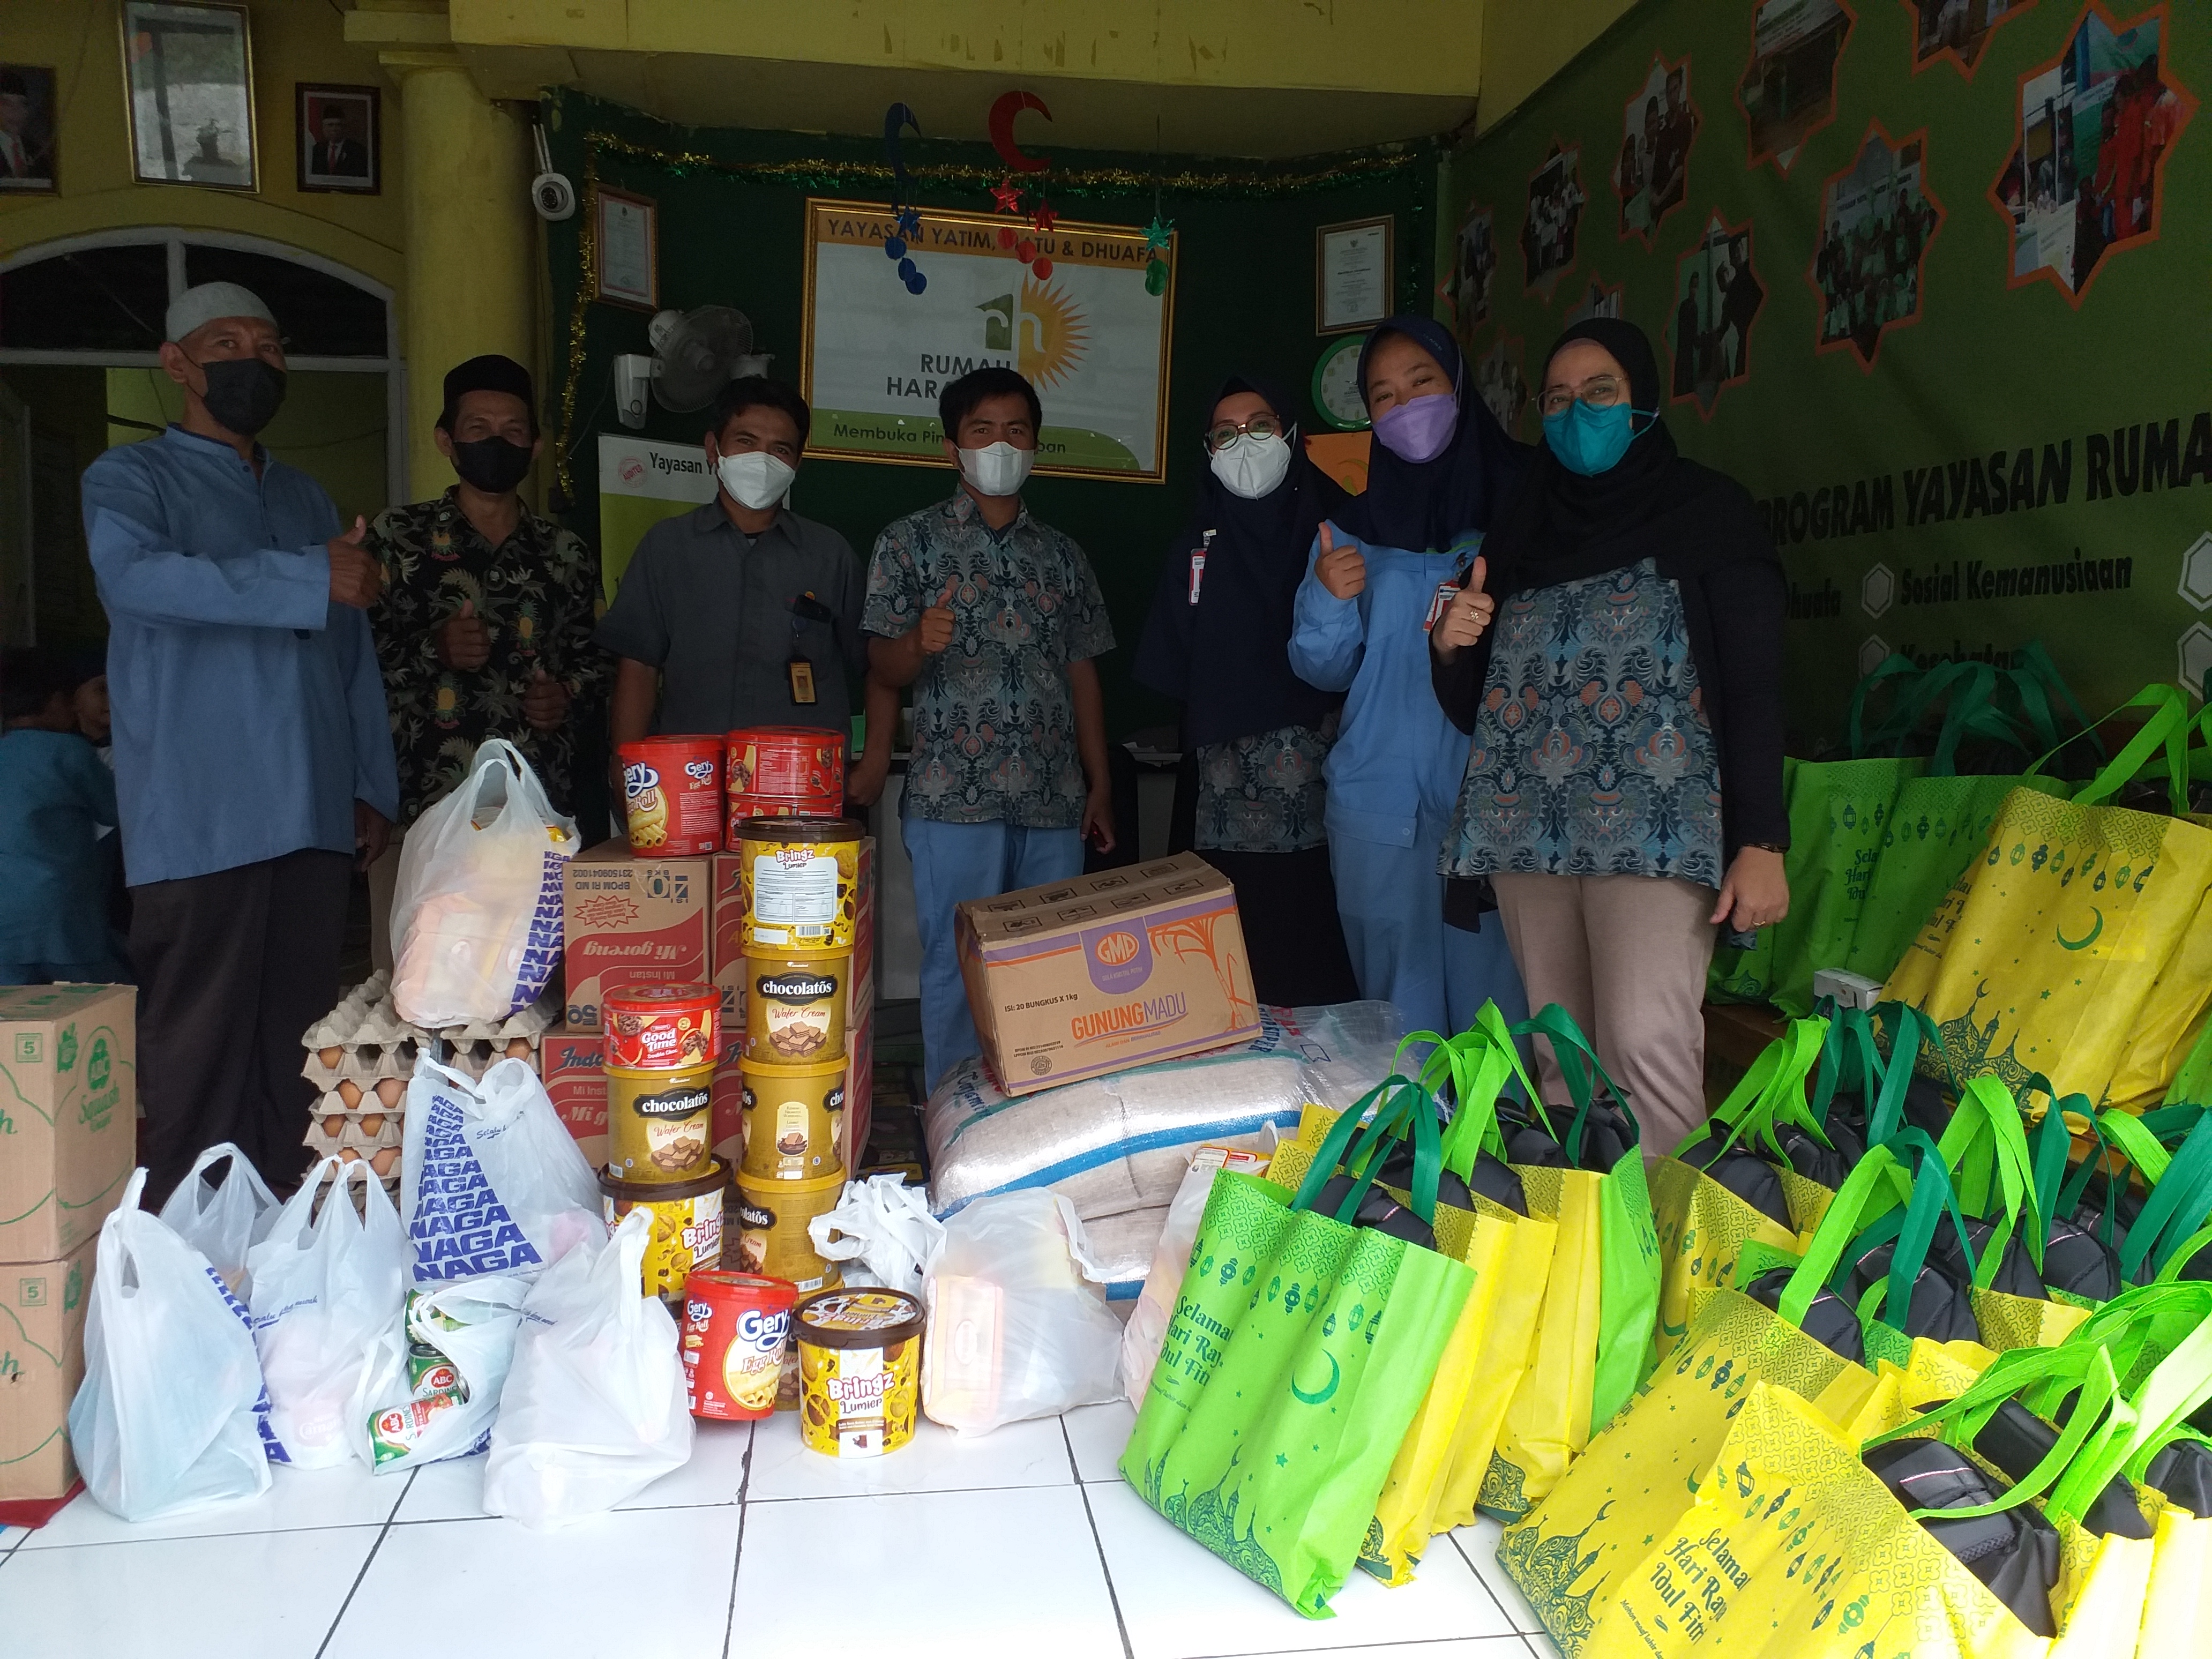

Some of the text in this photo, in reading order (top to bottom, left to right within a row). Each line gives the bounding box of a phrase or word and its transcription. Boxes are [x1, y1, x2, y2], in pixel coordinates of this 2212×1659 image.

[932, 227, 995, 251] YATIM,
[1062, 241, 1073, 256] &
[1081, 242, 1157, 263] DHUAFA
[833, 424, 945, 444] Membuka Pin
[649, 452, 703, 475] Yayasan
[1903, 438, 2072, 527] YAYASAN
[2086, 412, 2212, 502] RUMA
[1900, 561, 1960, 607] Sosial
[1966, 547, 2133, 601] Kemanusiaan
[684, 760, 714, 779] Gery
[701, 775, 712, 786] Roll
[635, 790, 659, 811] Roll
[775, 849, 815, 863] Bringz
[782, 862, 807, 870] Lumier
[575, 881, 630, 890] BPOM RI MD
[583, 941, 687, 960] Mi goreng
[1097, 933, 1137, 964] GMP
[630, 971, 675, 980] Mi Instan
[1016, 1003, 1025, 1011] 20
[1026, 996, 1059, 1009] BUNGKUS
[1059, 995, 1065, 1003] X
[1065, 993, 1079, 1001] 1kg
[772, 1007, 826, 1019] Wafer Cream
[641, 1028, 677, 1044] Good
[646, 1038, 677, 1053] Time
[23, 1041, 35, 1055] 5
[573, 1086, 608, 1095] Mi Inst
[654, 1120, 705, 1137] Wafer Cream
[412, 1242, 543, 1282] NAGA
[27, 1286, 39, 1298] 5
[687, 1299, 713, 1322] Gery
[696, 1319, 710, 1332] Roll
[737, 1308, 790, 1352] Gery
[1160, 1341, 1183, 1368] dul
[742, 1355, 768, 1376] Egg
[432, 1374, 454, 1386] ABC
[826, 1371, 895, 1401] Bringz
[840, 1398, 883, 1414] Lumier
[389, 1412, 403, 1433] ABC
[1663, 1536, 1708, 1585] Hari
[1649, 1561, 1687, 1609] Idul
[1619, 1598, 1638, 1623] Mohon
[1635, 1621, 1650, 1641] maaf
[1645, 1631, 1658, 1653] lahir
